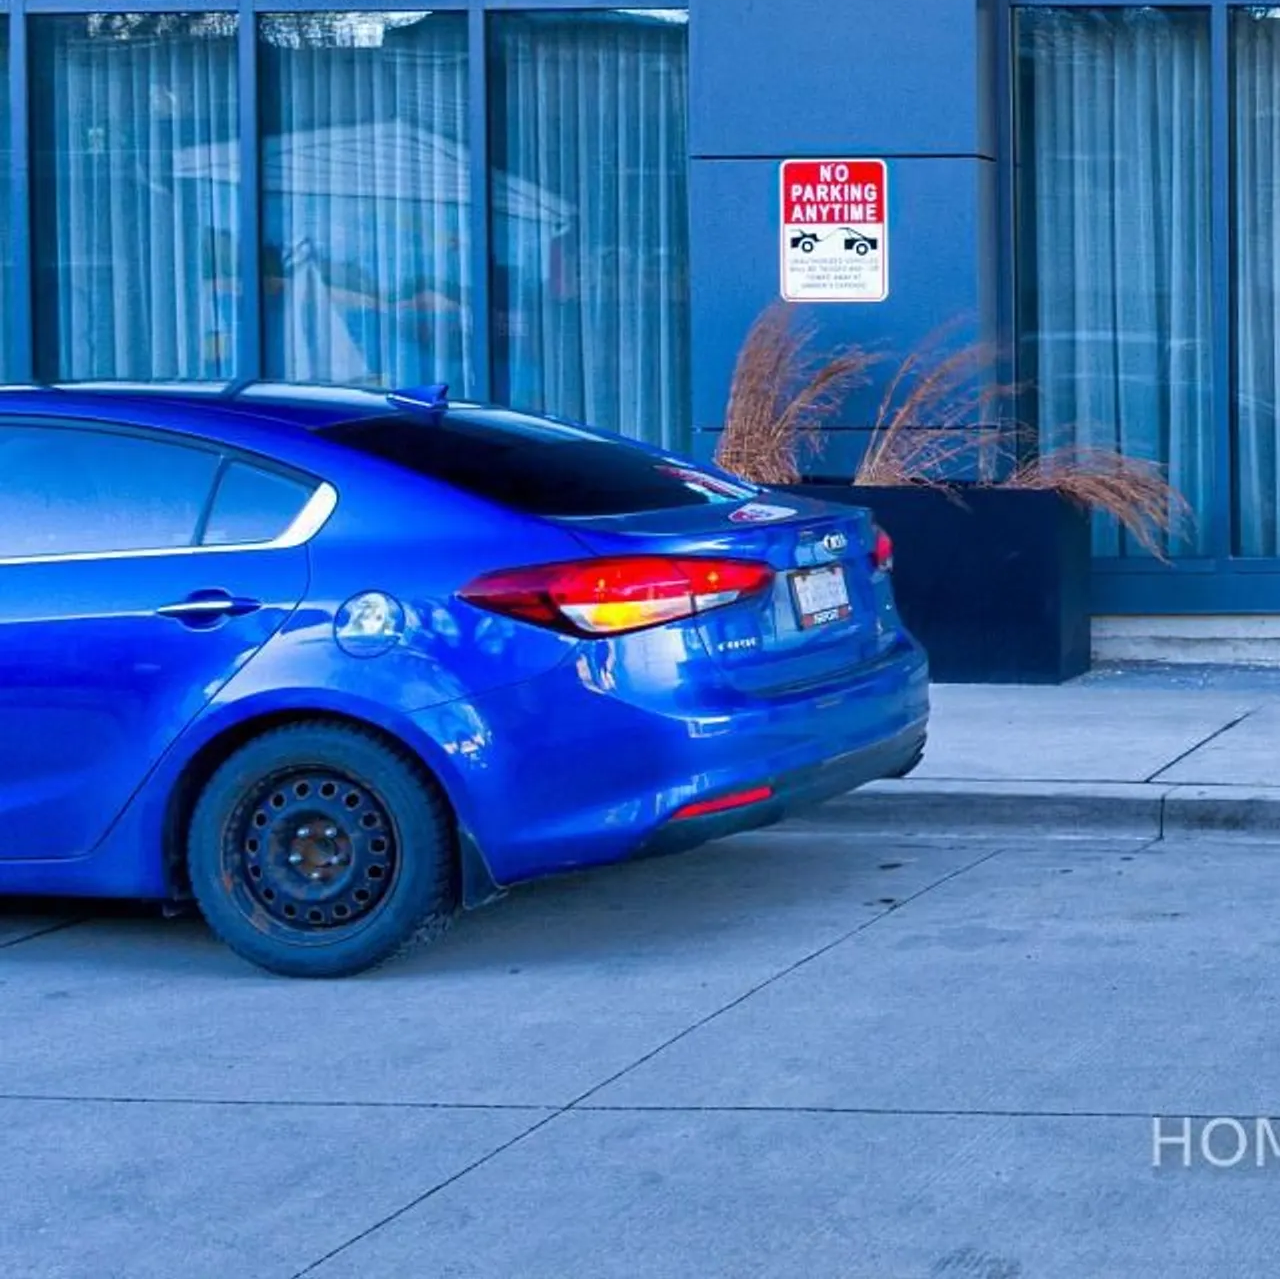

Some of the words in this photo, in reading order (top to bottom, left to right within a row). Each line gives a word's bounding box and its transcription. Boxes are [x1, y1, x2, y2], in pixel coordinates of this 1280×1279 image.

[820, 164, 849, 182] NO
[791, 183, 877, 202] PARKING
[791, 203, 877, 222] ANYTIME
